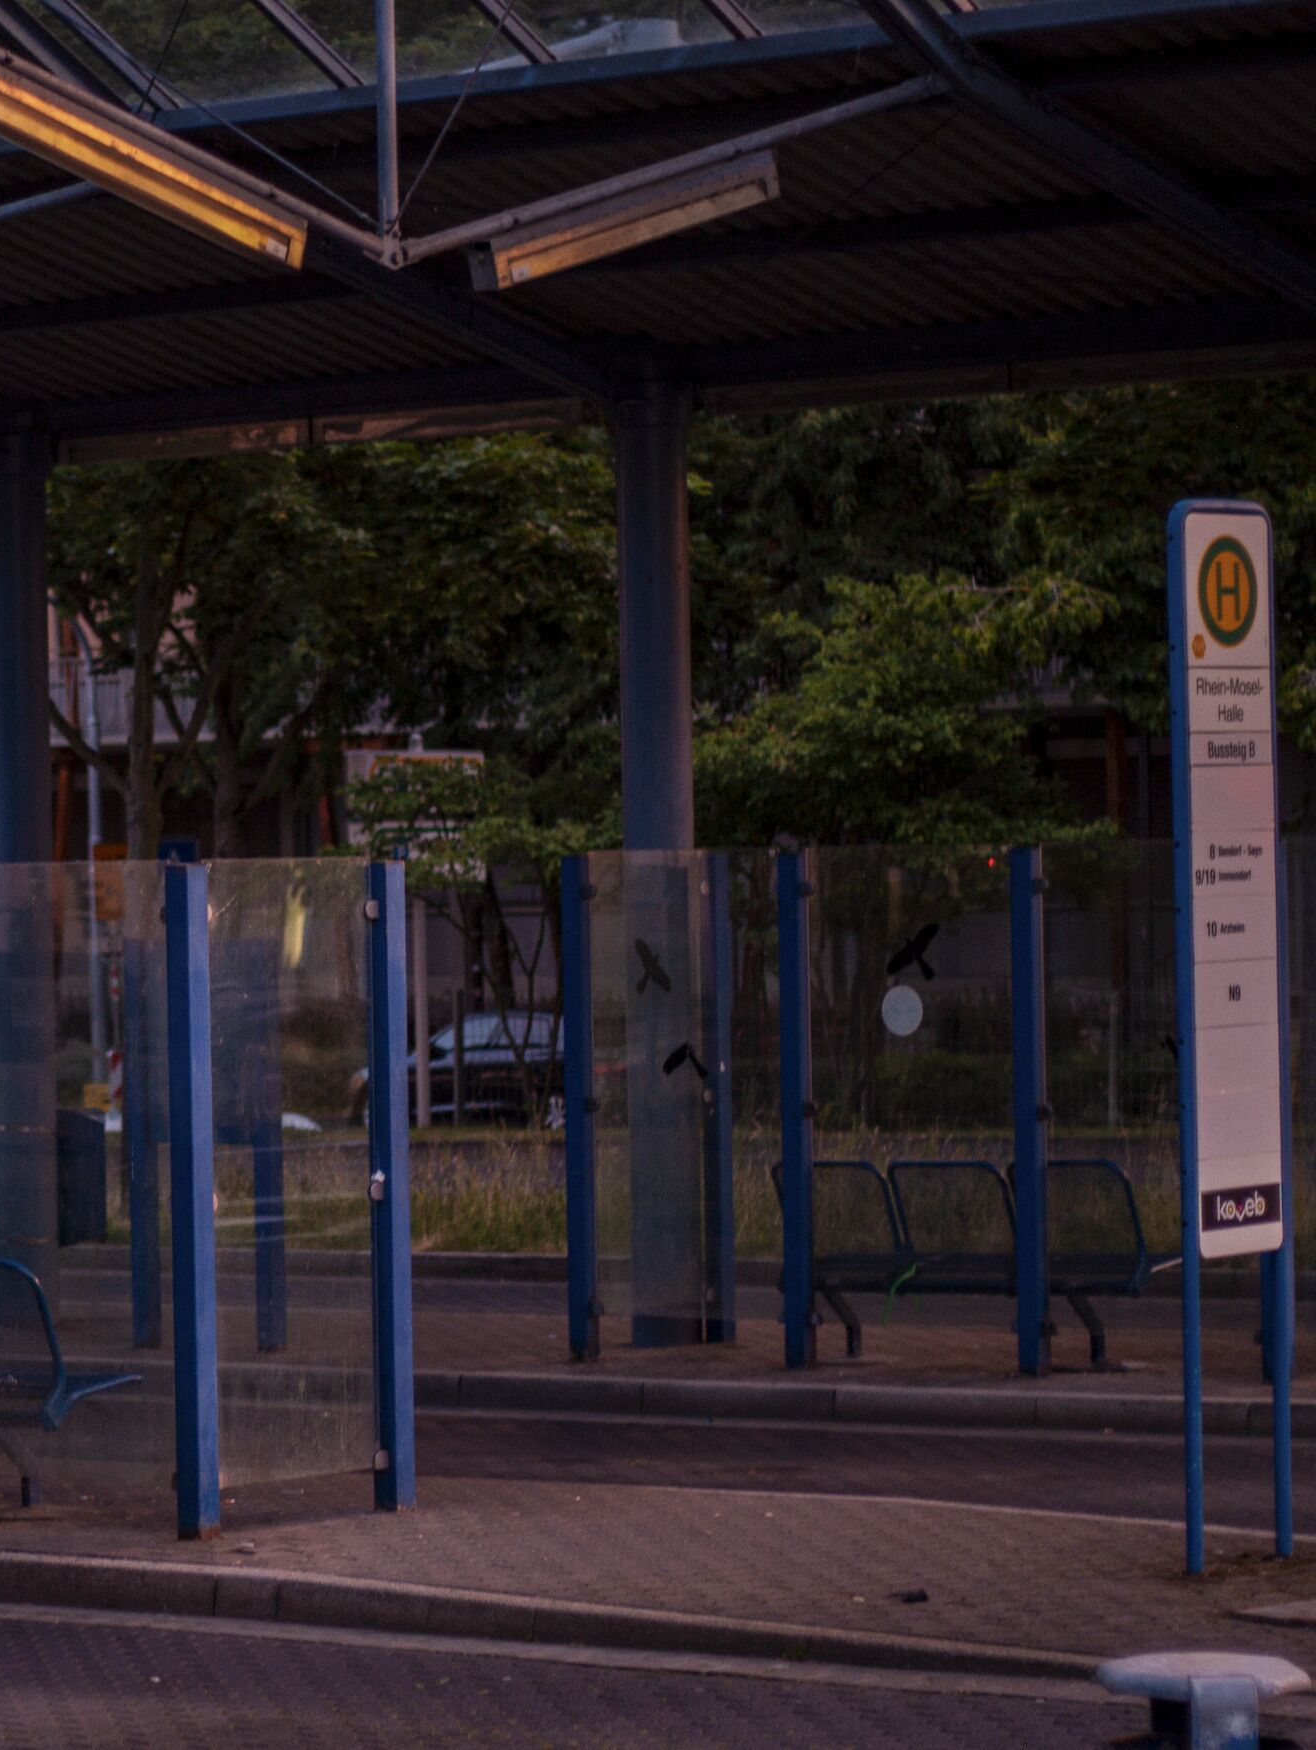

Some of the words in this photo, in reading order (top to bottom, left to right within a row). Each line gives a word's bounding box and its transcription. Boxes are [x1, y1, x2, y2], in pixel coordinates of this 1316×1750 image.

[1216, 562, 1240, 621] H
[1196, 678, 1263, 697] Rhein-Mosel-
[1217, 704, 1244, 723] Halle
[1207, 741, 1247, 762] Bussteig
[1249, 742, 1256, 758] B
[1195, 869, 1216, 886] 9/19
[1206, 920, 1217, 938] 10
[1229, 985, 1241, 1002] N9
[1216, 1190, 1265, 1222] koveb
